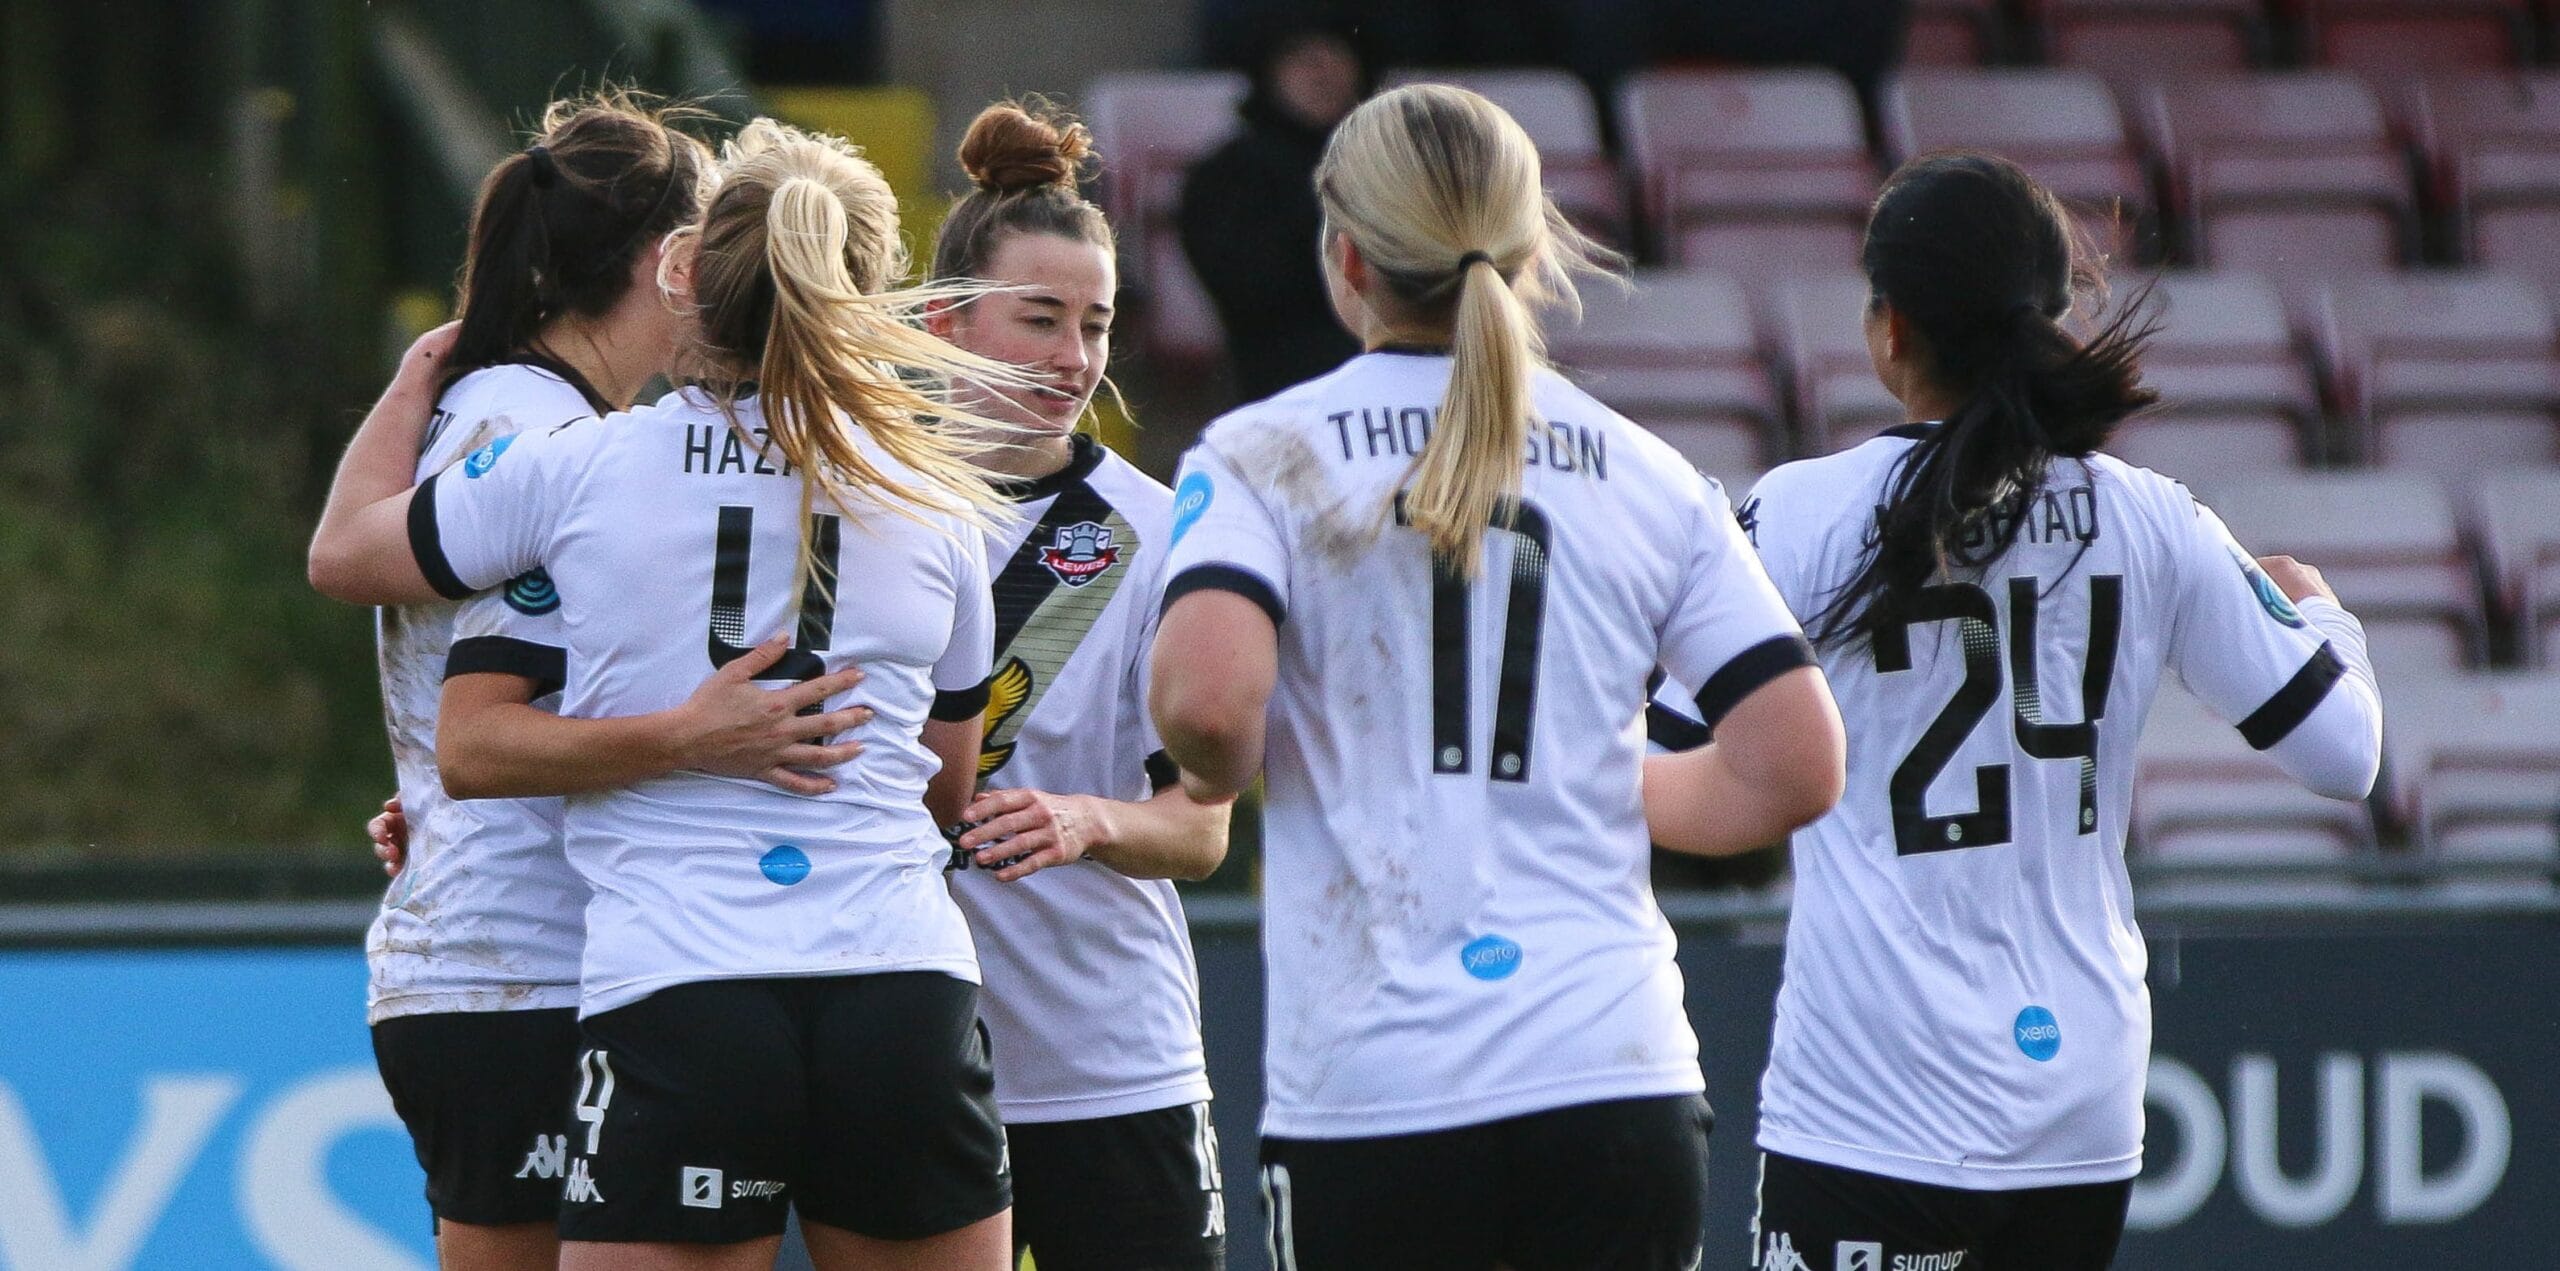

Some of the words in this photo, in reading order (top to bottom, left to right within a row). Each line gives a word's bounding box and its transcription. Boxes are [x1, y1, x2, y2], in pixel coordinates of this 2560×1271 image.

[1052, 558, 1107, 572] LEWES
[1068, 574, 1087, 583] FC
[1875, 574, 2124, 856] 24
[2018, 1024, 2058, 1041] xero
[576, 1049, 615, 1154] 4
